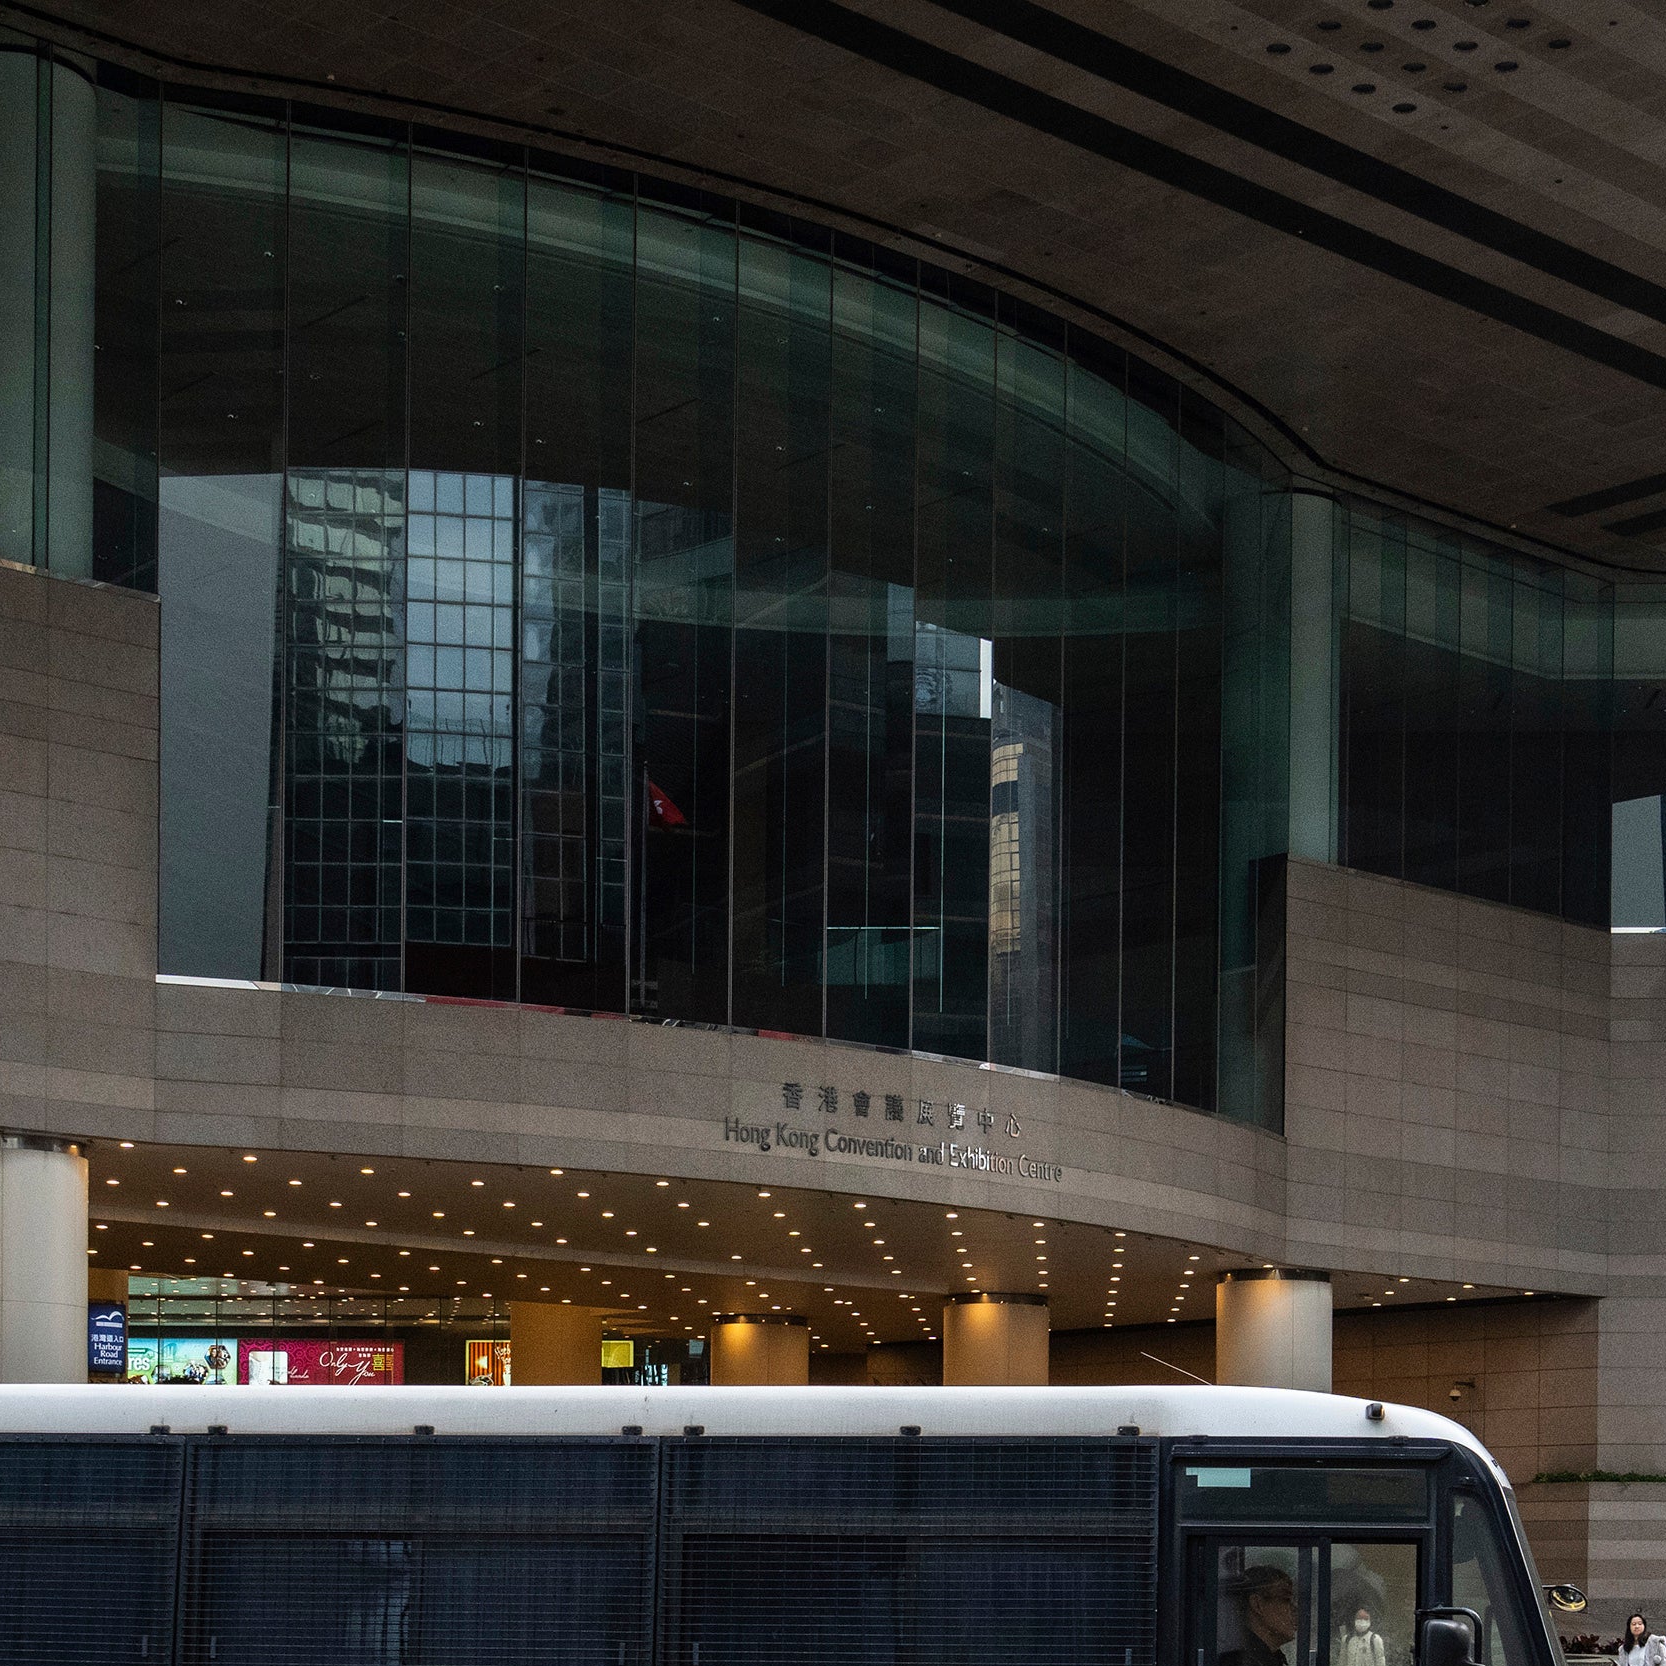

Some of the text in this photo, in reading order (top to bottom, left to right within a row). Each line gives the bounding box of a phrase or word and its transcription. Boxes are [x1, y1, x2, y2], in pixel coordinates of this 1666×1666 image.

[783, 1082, 1022, 1138] 香港會議展覽中心
[725, 1116, 1063, 1182] Hong Kong Convention and Exhibition Centre
[94, 1342, 123, 1351] Harbour
[100, 1350, 119, 1358] Road
[93, 1356, 123, 1366] Entrance
[319, 1351, 349, 1377] Only
